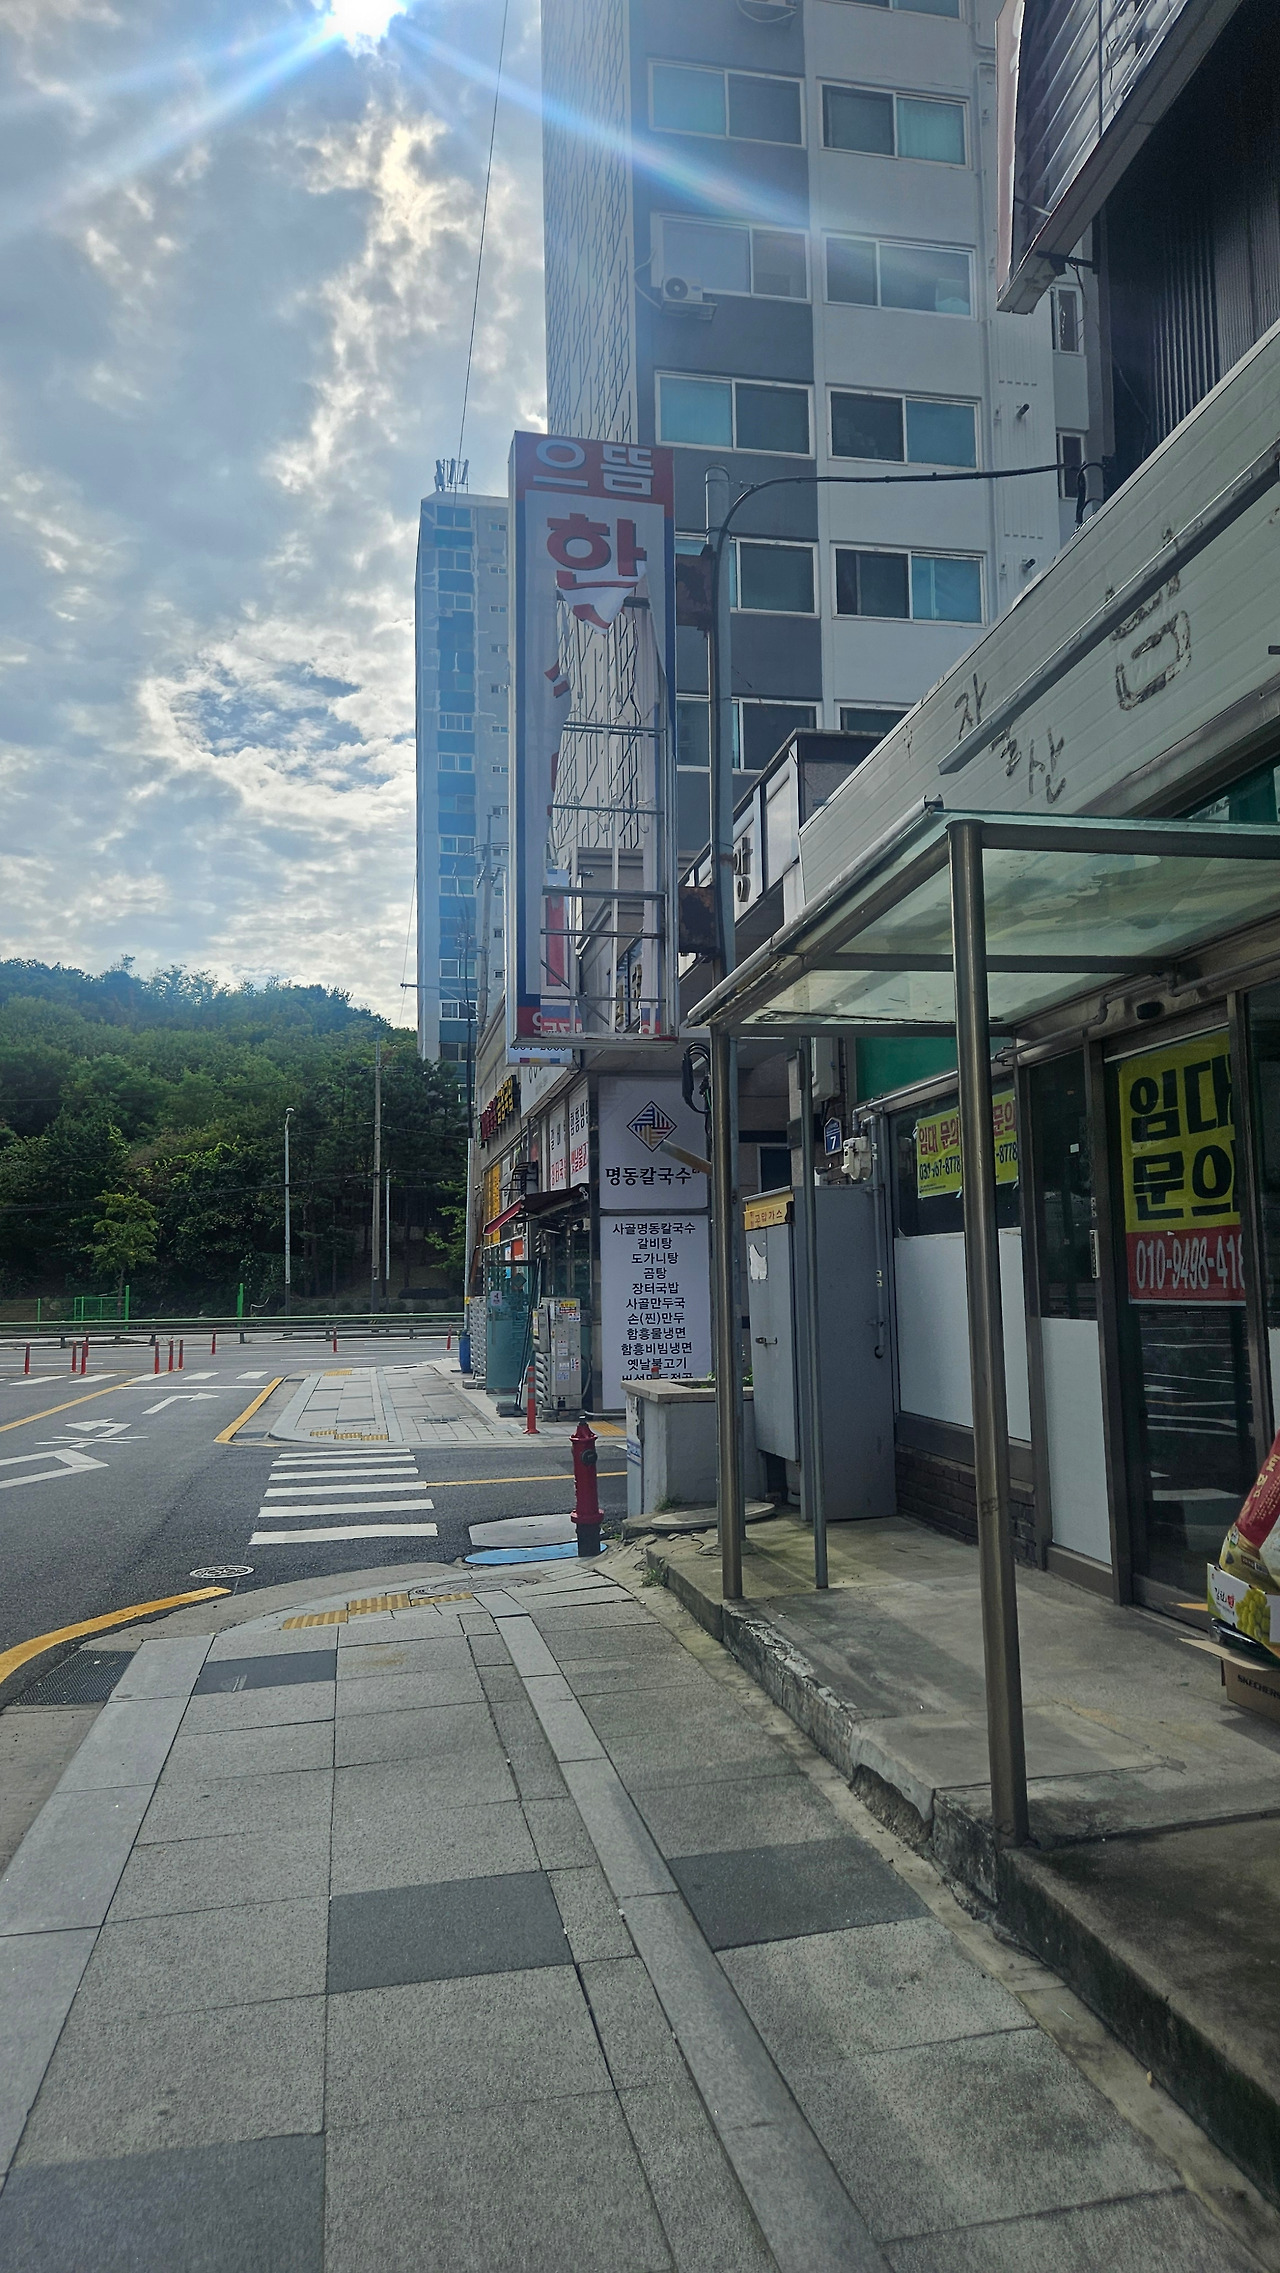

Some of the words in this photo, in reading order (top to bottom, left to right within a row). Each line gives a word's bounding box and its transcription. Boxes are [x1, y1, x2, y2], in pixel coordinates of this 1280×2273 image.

[533, 439, 655, 496] 으뜸
[830, 1135, 837, 1150] 7
[919, 1124, 938, 1155] 임대
[940, 1117, 959, 1150] 문의
[605, 1166, 692, 1186] 명동칼국수
[613, 1222, 696, 1235] 사골명동칼국수
[637, 1237, 672, 1250] 갈비탕
[631, 1252, 679, 1265] 도가니탕
[1136, 1233, 1246, 1290] 010-9498-41
[643, 1267, 667, 1280] 곰탕
[632, 1282, 679, 1295] 장터국밥
[626, 1297, 686, 1310] 사골만두국
[627, 1312, 685, 1325] 손(찐)만두
[626, 1327, 686, 1340] 함흥물냉면
[621, 1341, 693, 1356] 함흥비빔냉면
[627, 1357, 687, 1371] 옛날불고기
